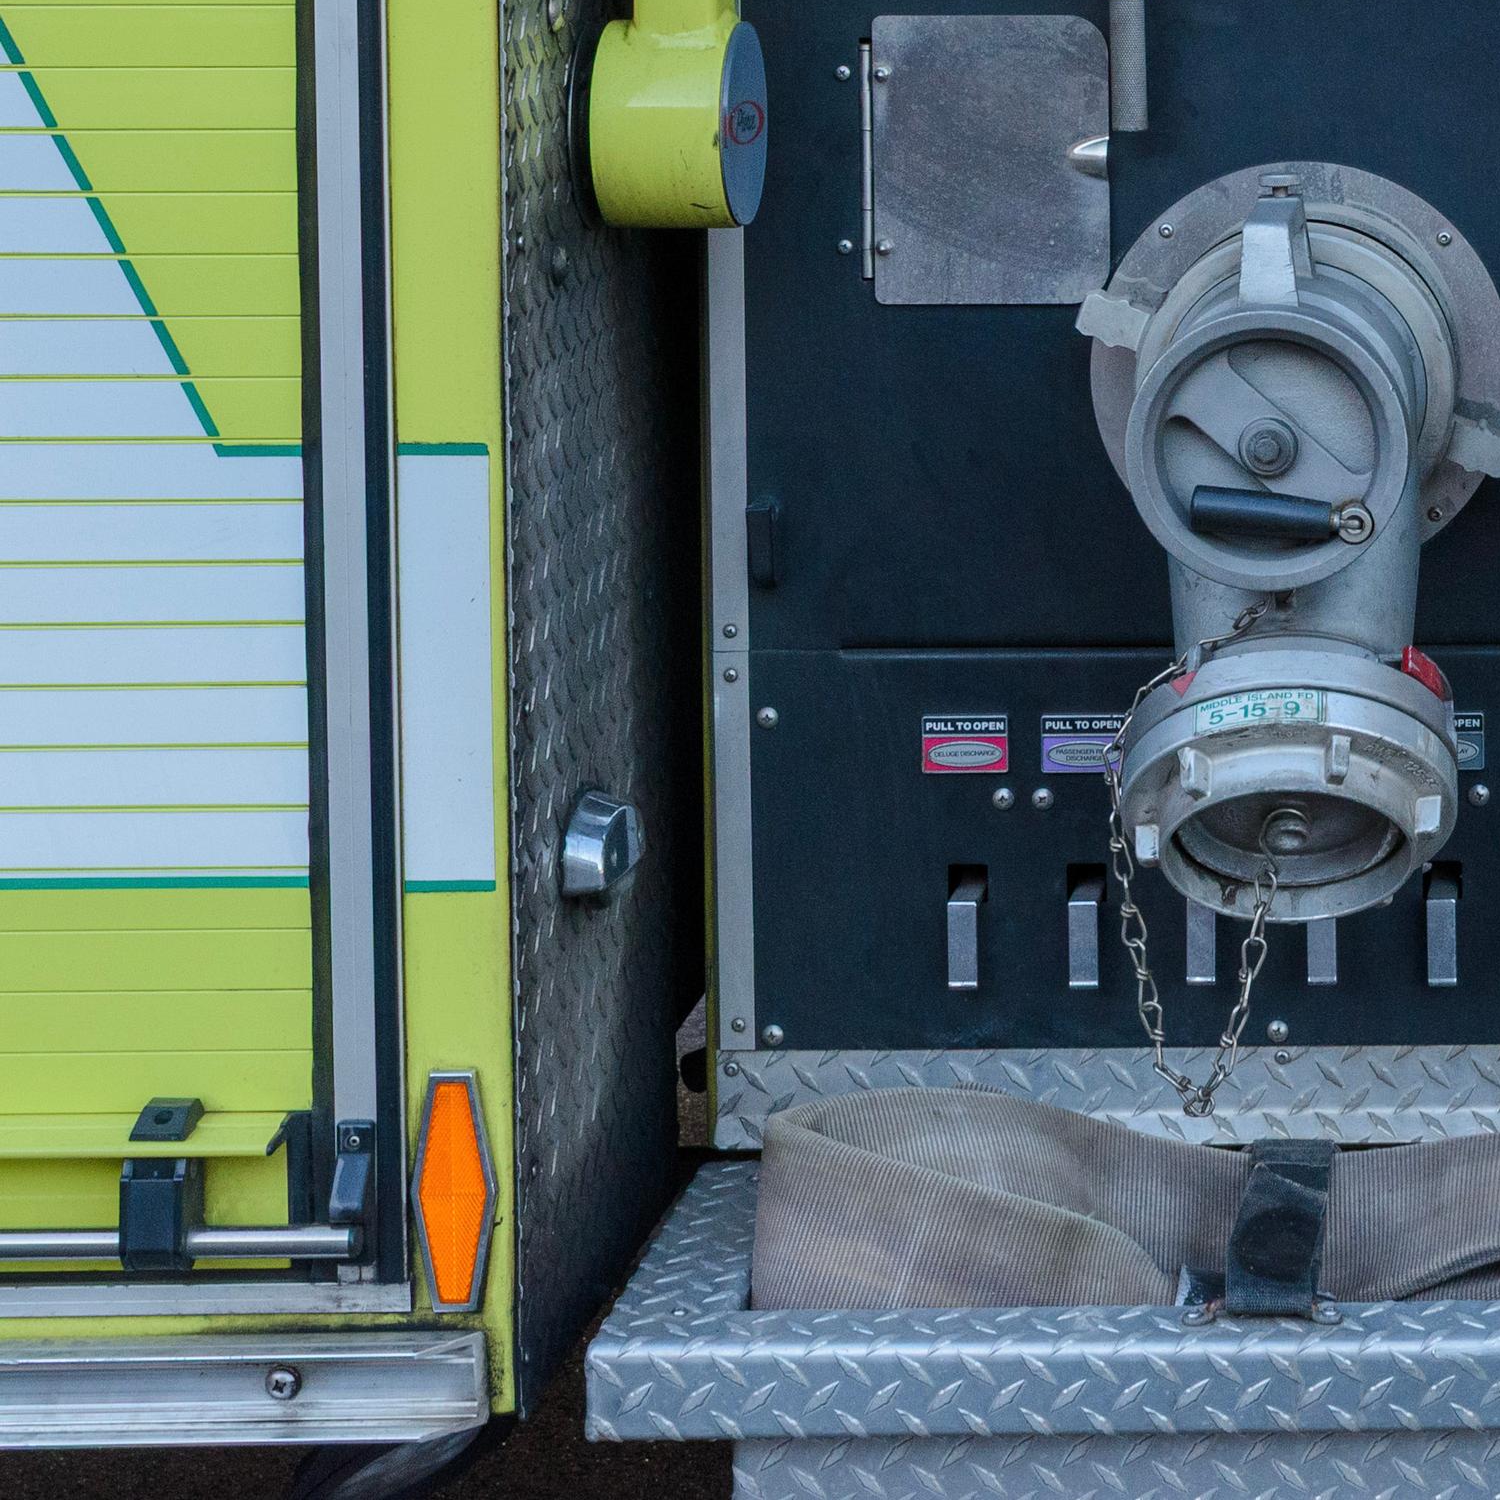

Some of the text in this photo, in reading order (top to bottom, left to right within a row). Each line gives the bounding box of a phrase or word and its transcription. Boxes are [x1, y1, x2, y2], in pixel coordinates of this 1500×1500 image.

[1200, 692, 1314, 713] MIDDLE ISLAND FD
[1208, 700, 1301, 725] 5-15-9
[925, 722, 1004, 731] PULL TO OPEN
[1045, 720, 1121, 730] PULL TO OPEN
[934, 750, 959, 758] DELUGE
